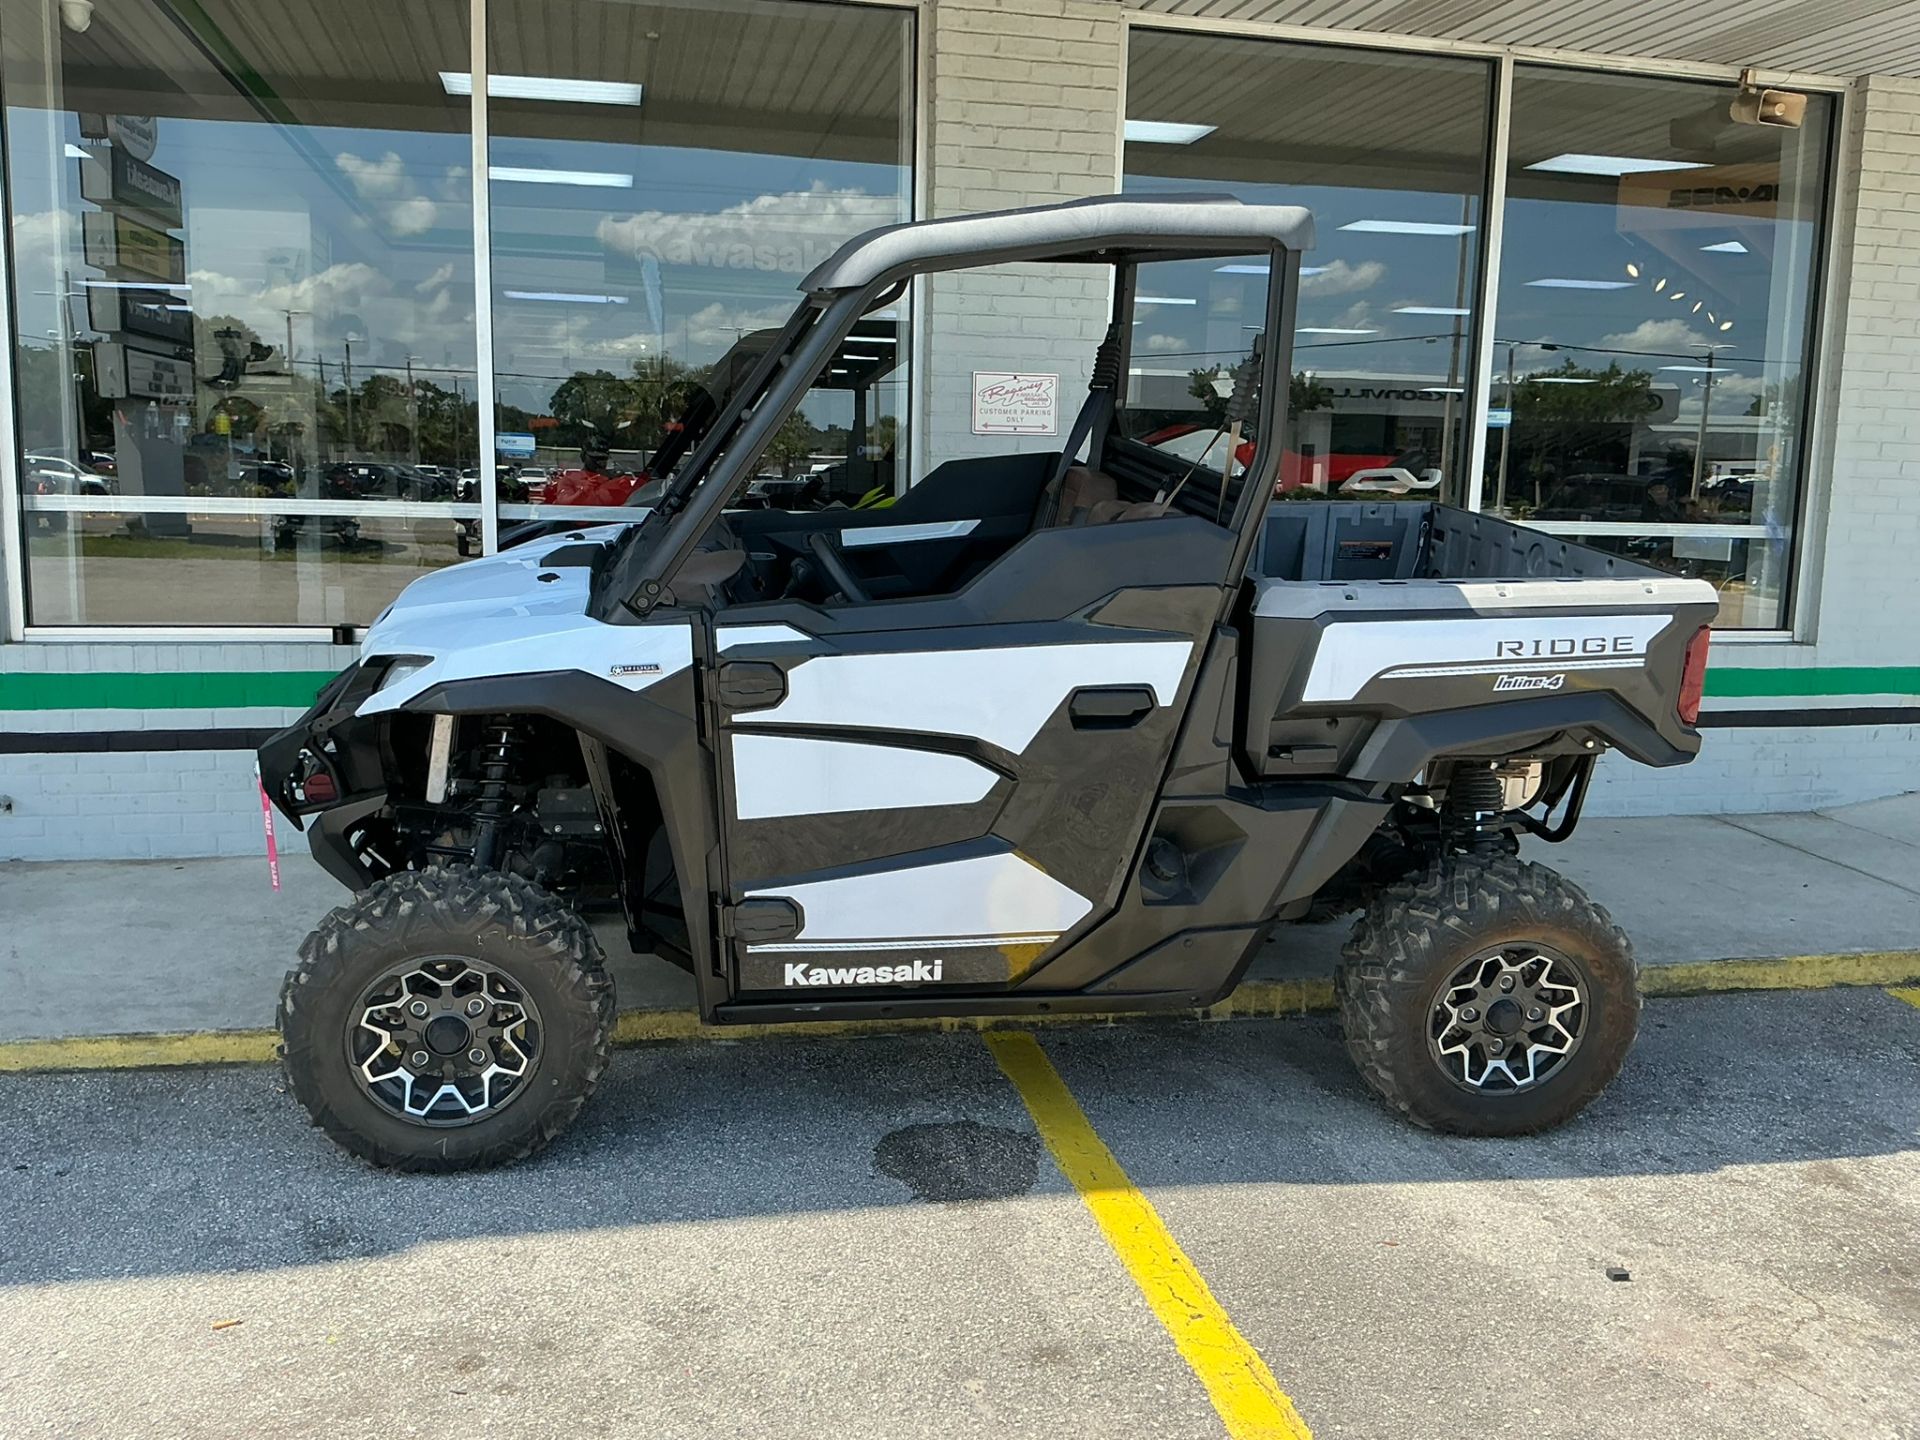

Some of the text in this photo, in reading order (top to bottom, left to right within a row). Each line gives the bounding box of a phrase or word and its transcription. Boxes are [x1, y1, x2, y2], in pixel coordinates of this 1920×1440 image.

[634, 226, 842, 273] Kawasak
[979, 408, 1018, 416] CUSTOMER
[1497, 636, 1634, 656] RIDGE
[1494, 674, 1566, 691] Inline-4
[784, 960, 943, 986] Kawasaki
